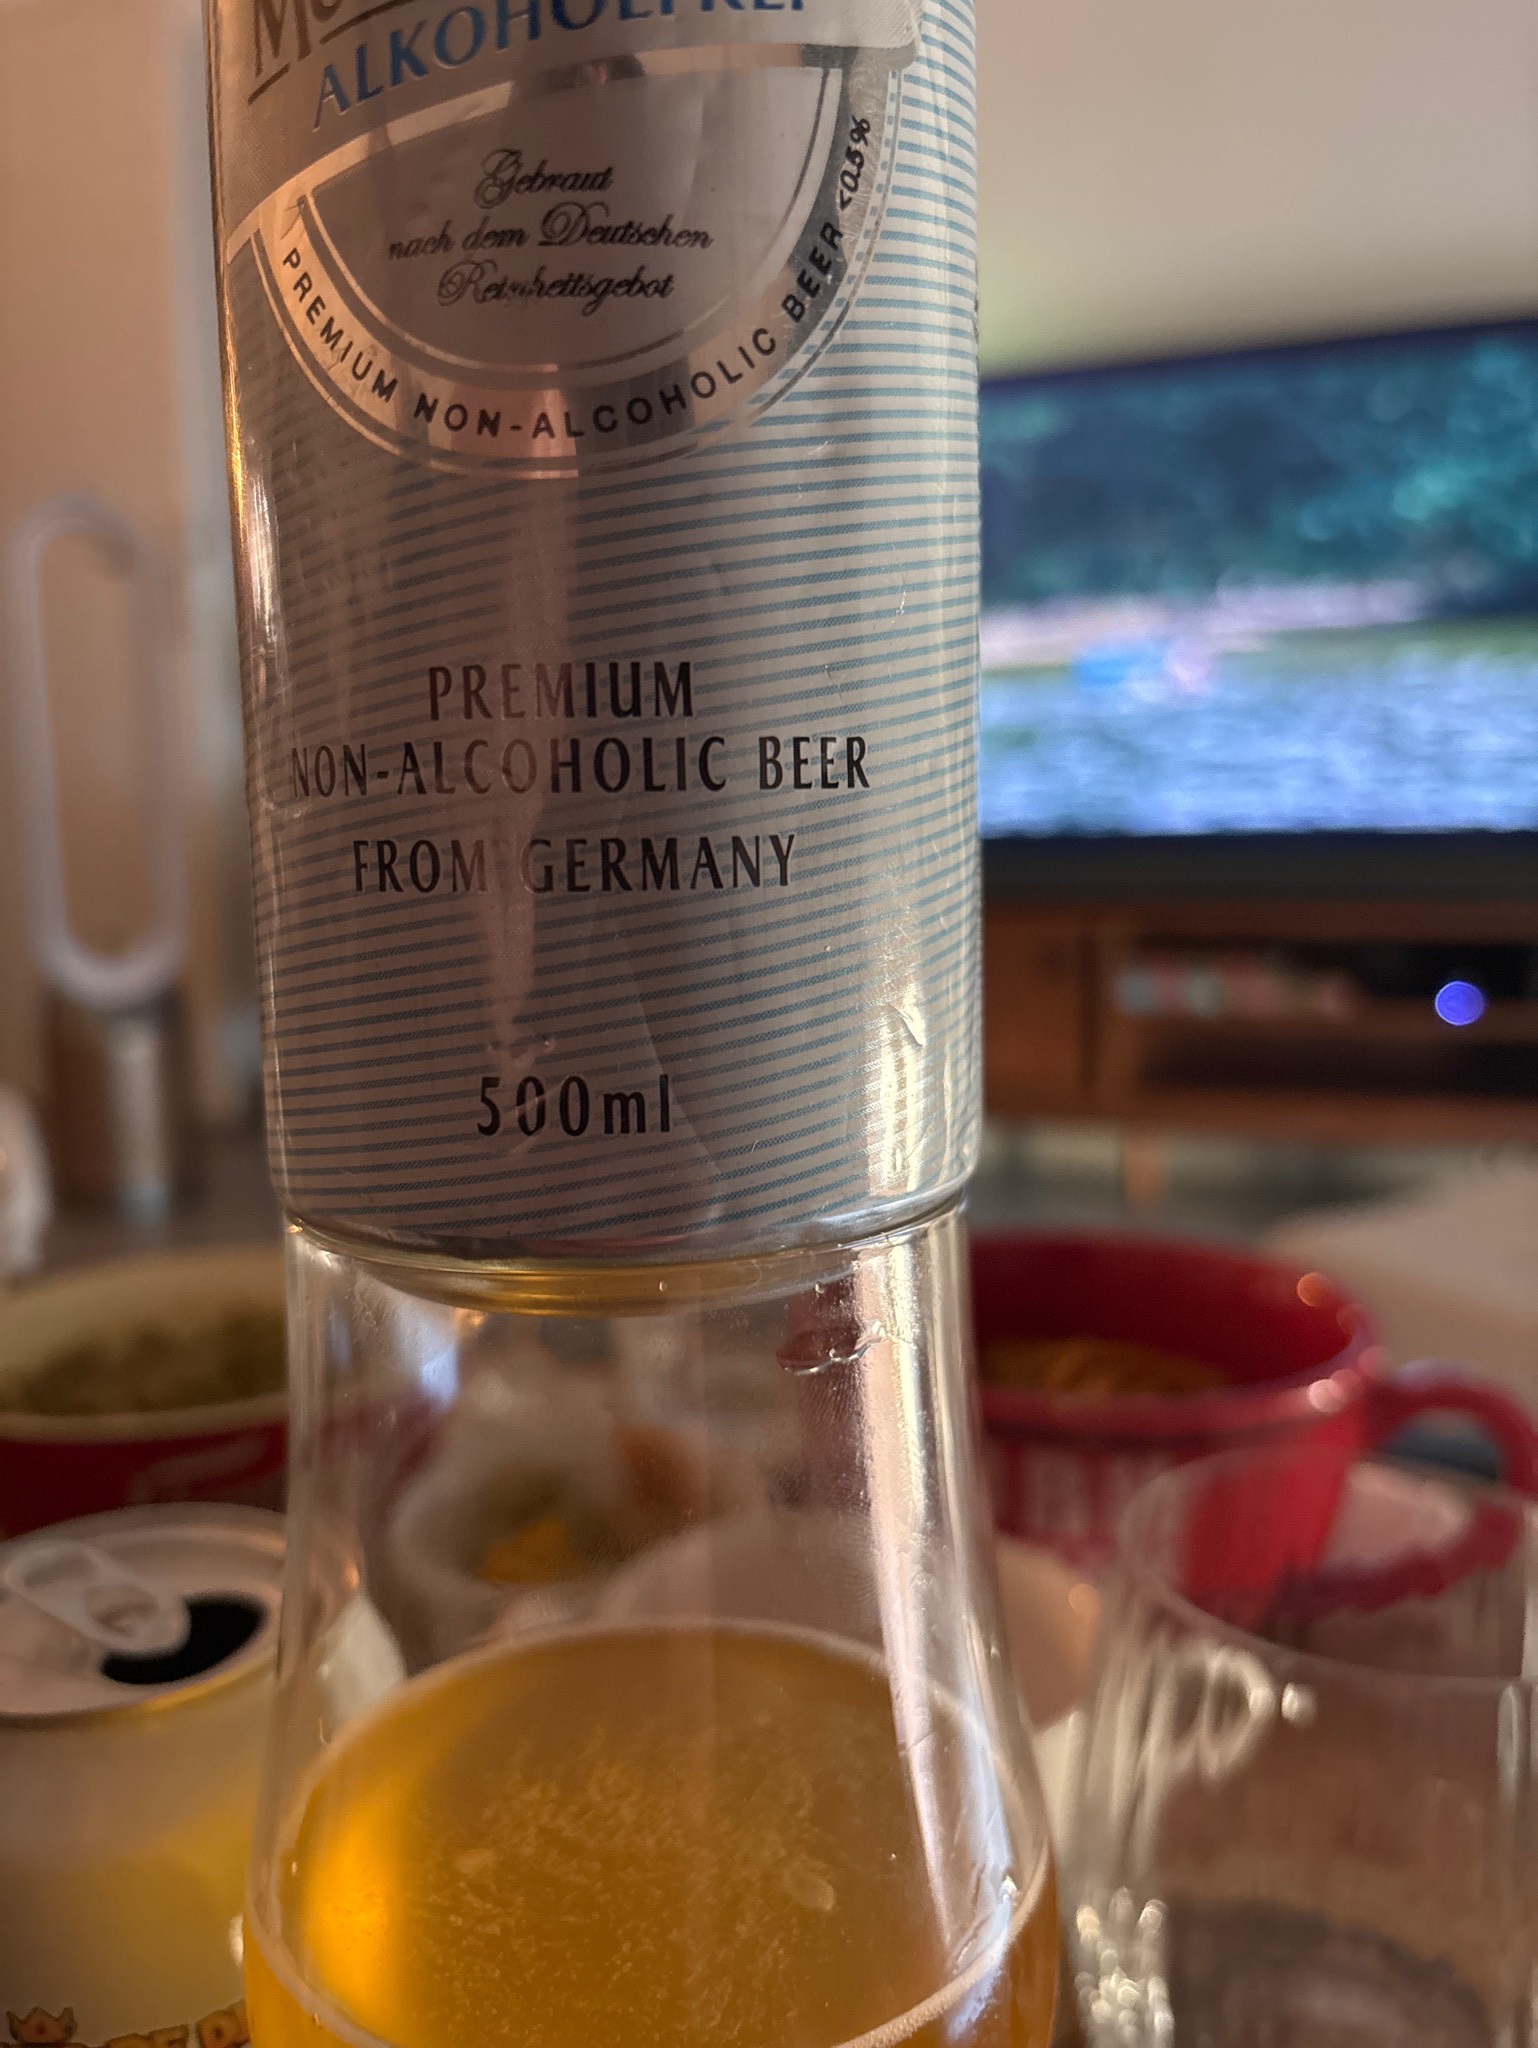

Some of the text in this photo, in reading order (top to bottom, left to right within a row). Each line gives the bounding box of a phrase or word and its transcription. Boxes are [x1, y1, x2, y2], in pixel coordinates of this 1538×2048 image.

[312, 0, 804, 132] ALKOHO
[474, 149, 613, 210] Gebraut
[388, 201, 713, 261] nach dem Deutschen
[282, 115, 871, 440] PREMIUM NON-ALCOHOLIC BEER <0.5%
[428, 660, 695, 722] PREMIUM
[291, 734, 871, 799] NON-ALCOHOLIC BEER
[353, 833, 796, 893] FROM GERMANY
[476, 1073, 672, 1137] 500ml
